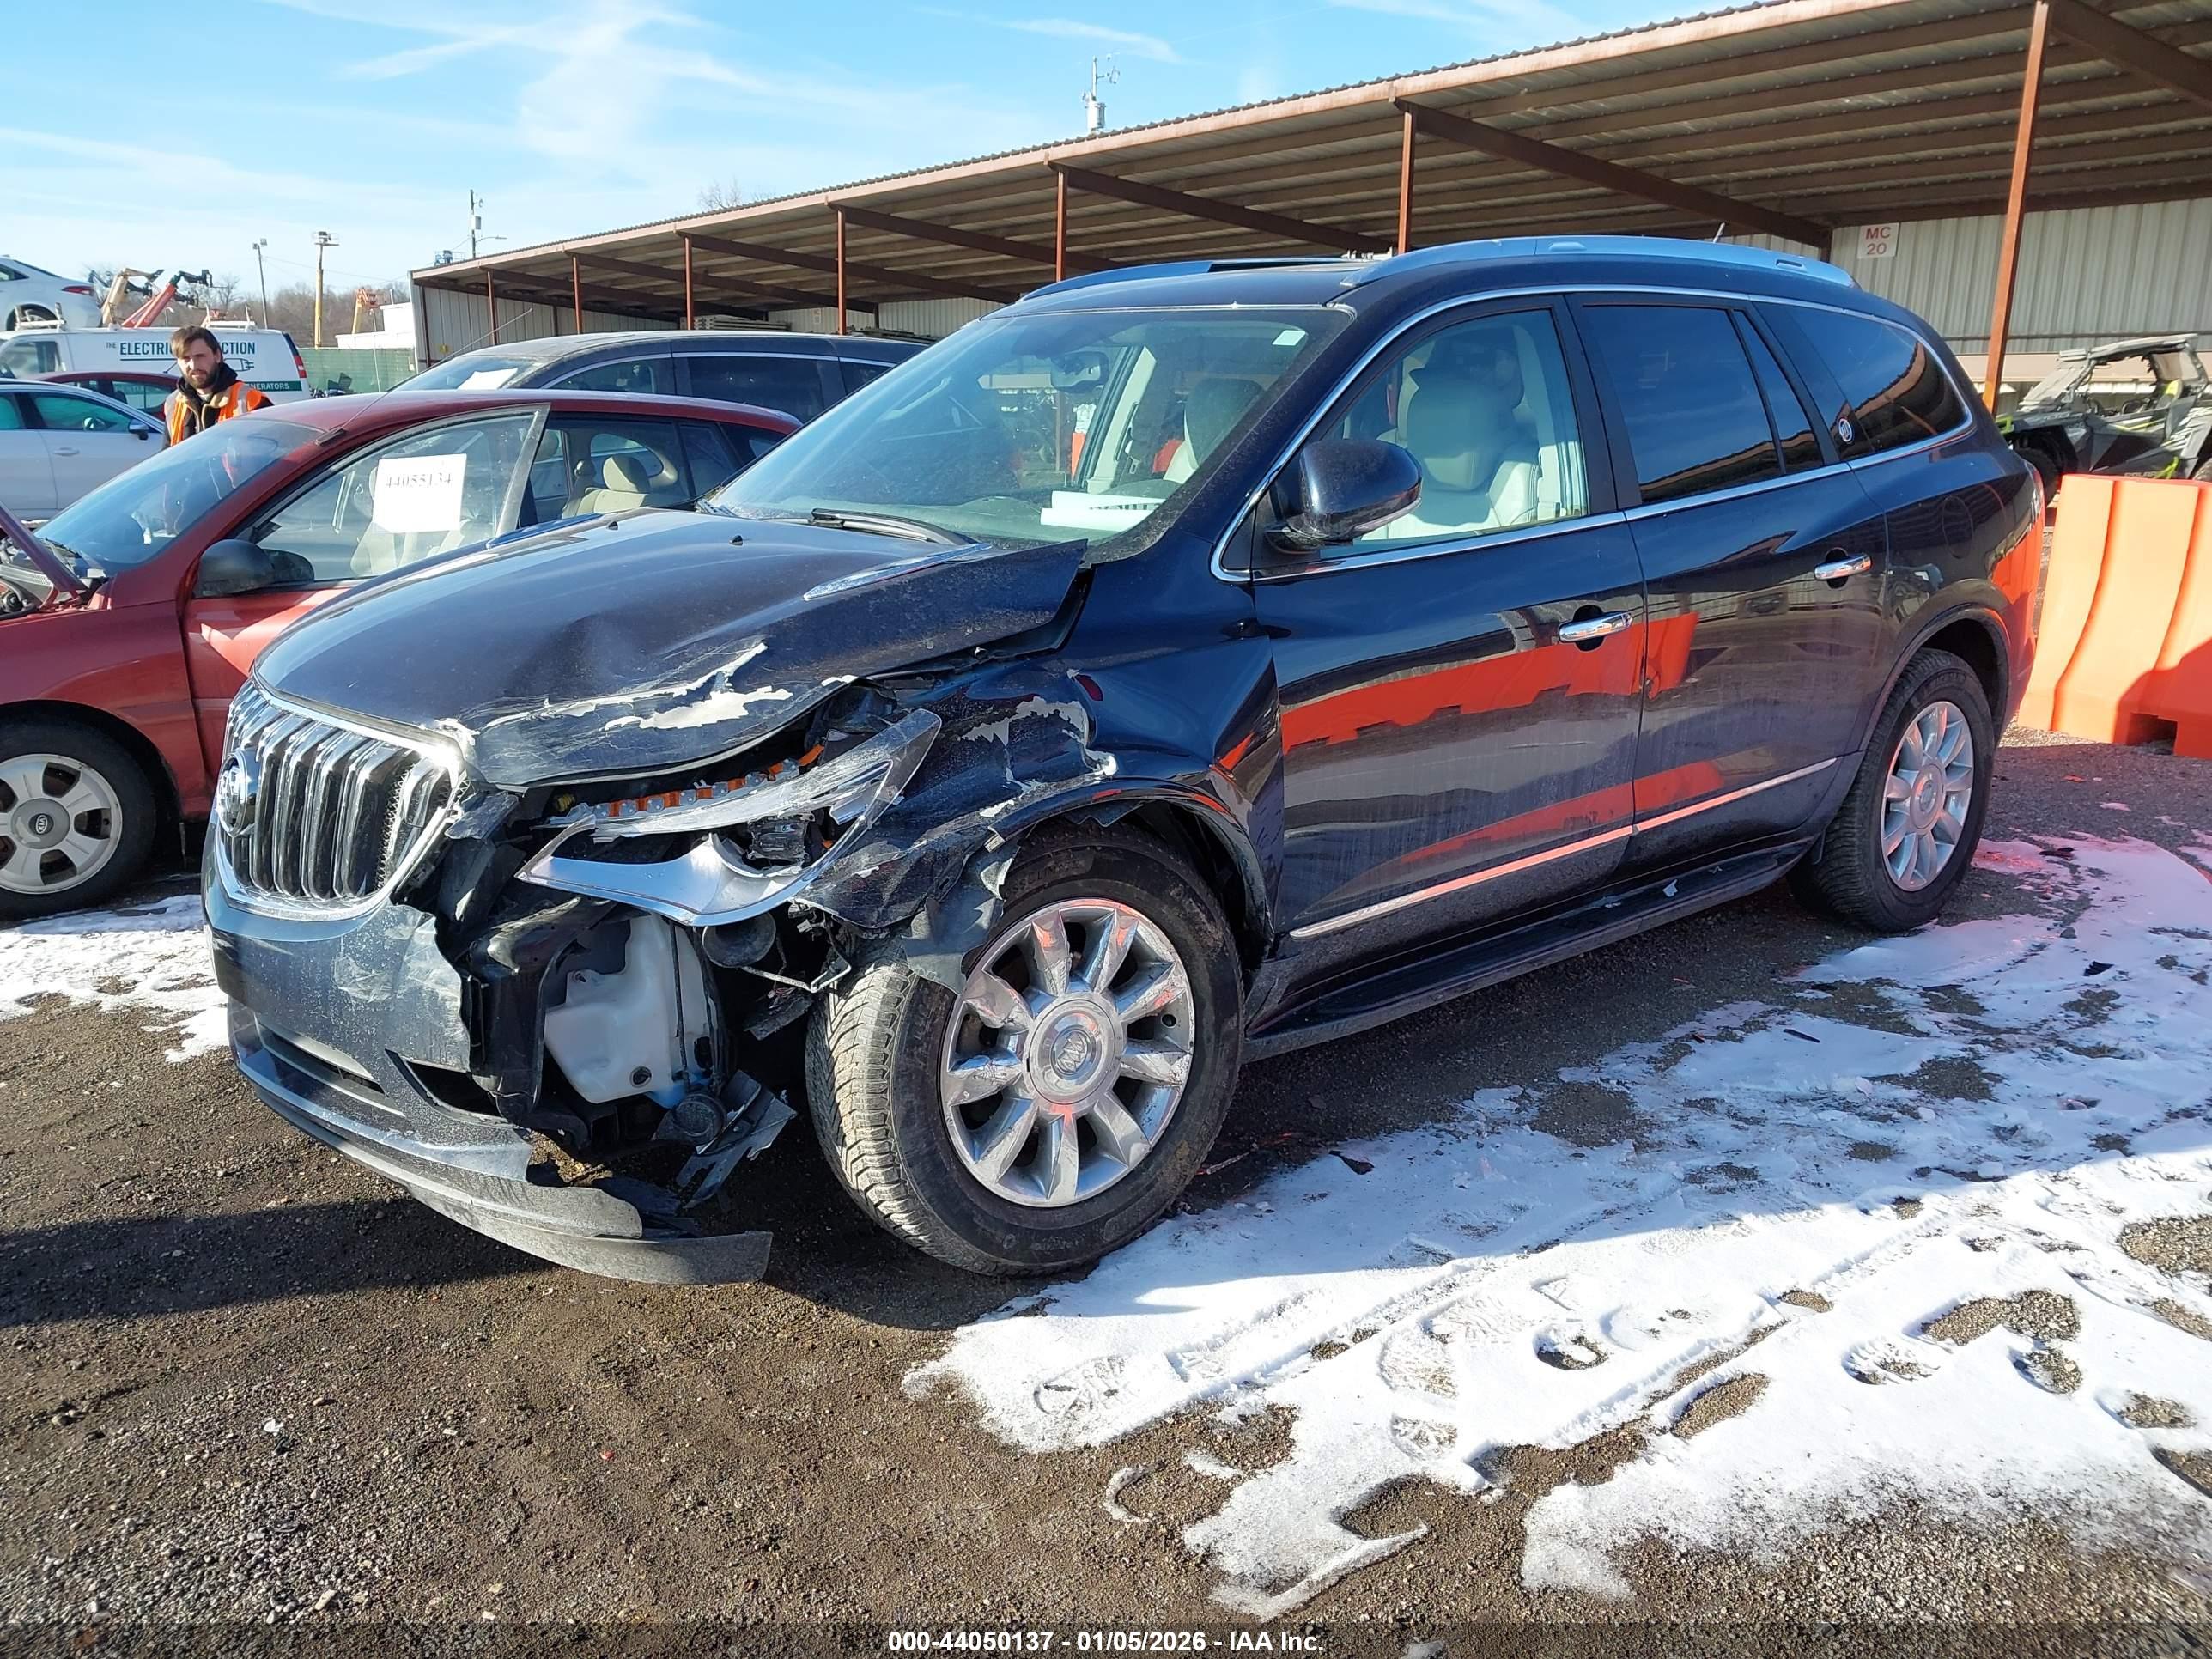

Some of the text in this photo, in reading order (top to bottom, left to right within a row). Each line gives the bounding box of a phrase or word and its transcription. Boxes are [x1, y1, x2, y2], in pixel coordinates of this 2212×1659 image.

[1865, 226, 1892, 240] MC
[1866, 242, 1887, 255] 20
[220, 342, 256, 355] CTION
